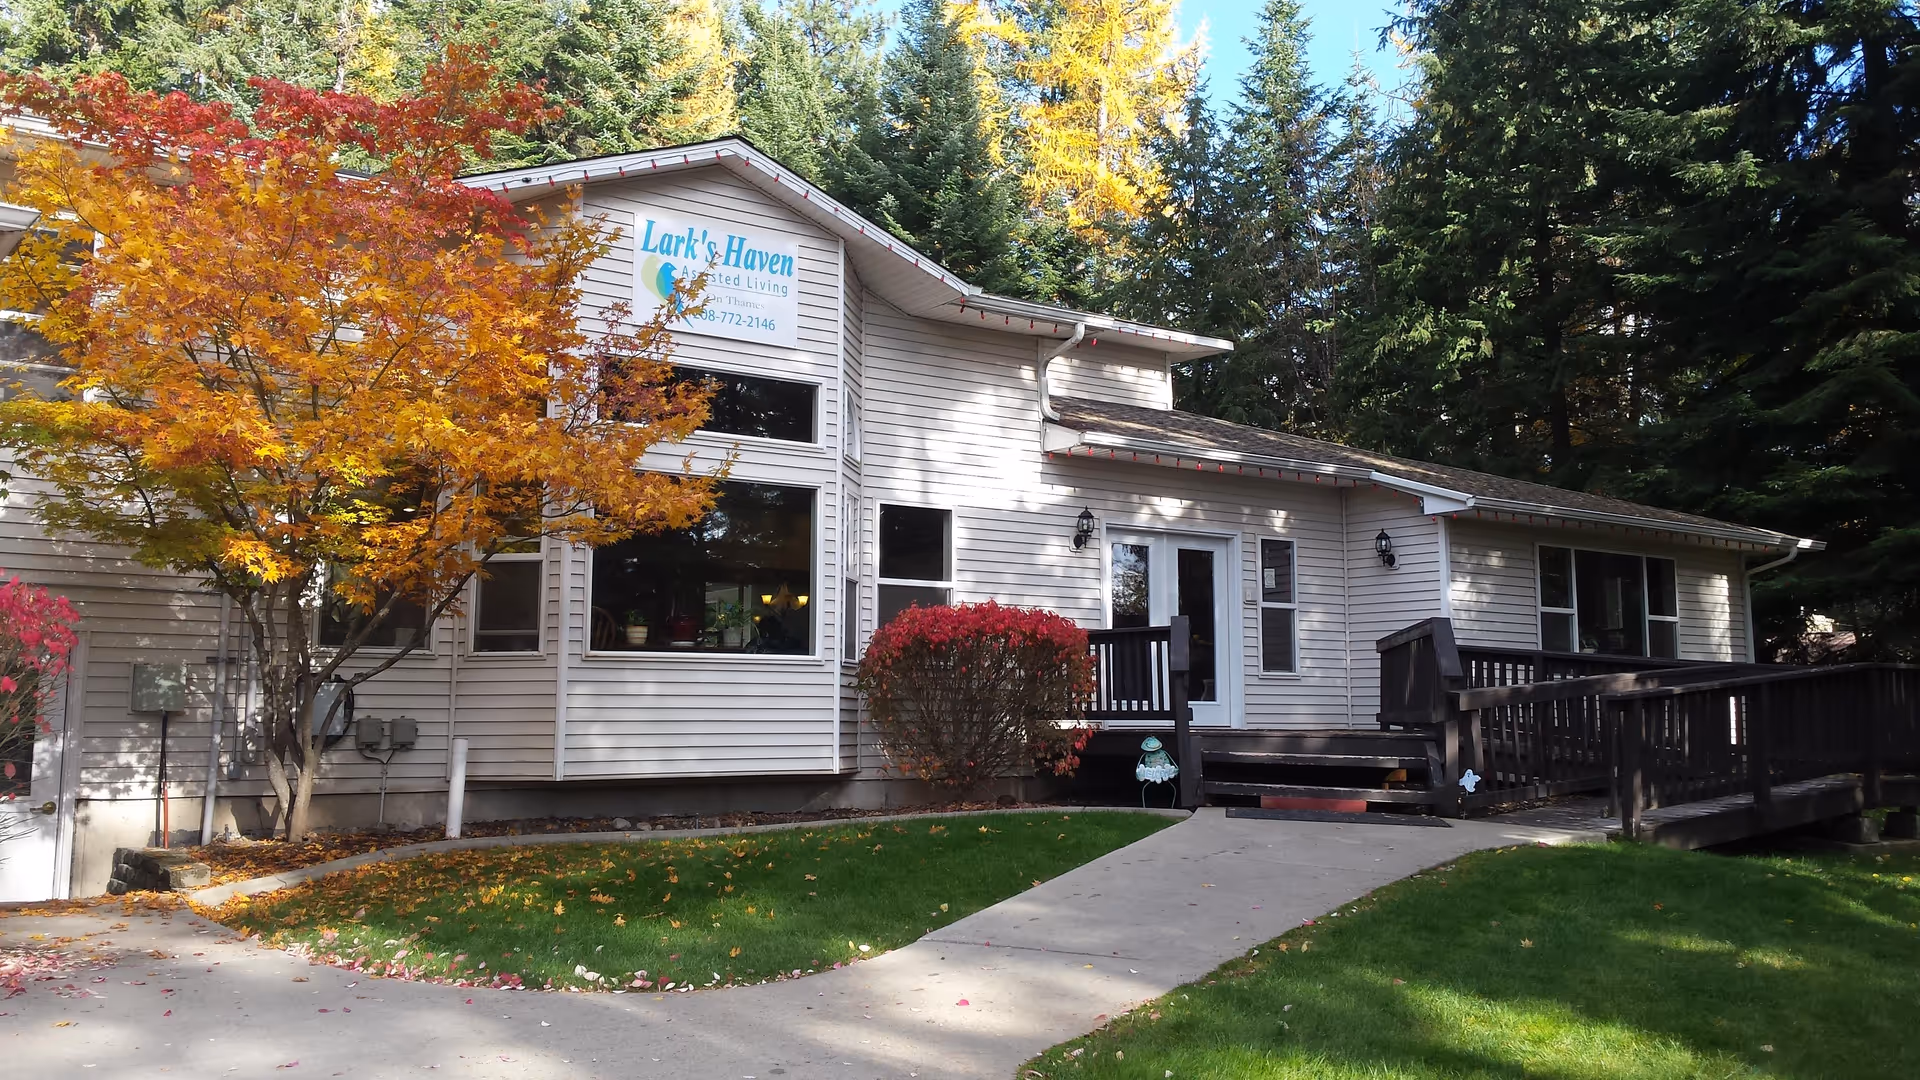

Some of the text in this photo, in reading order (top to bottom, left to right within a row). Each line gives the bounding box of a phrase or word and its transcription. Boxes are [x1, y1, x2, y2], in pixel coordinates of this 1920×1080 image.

[641, 219, 794, 277] Lark's Haven
[748, 277, 788, 298] Living
